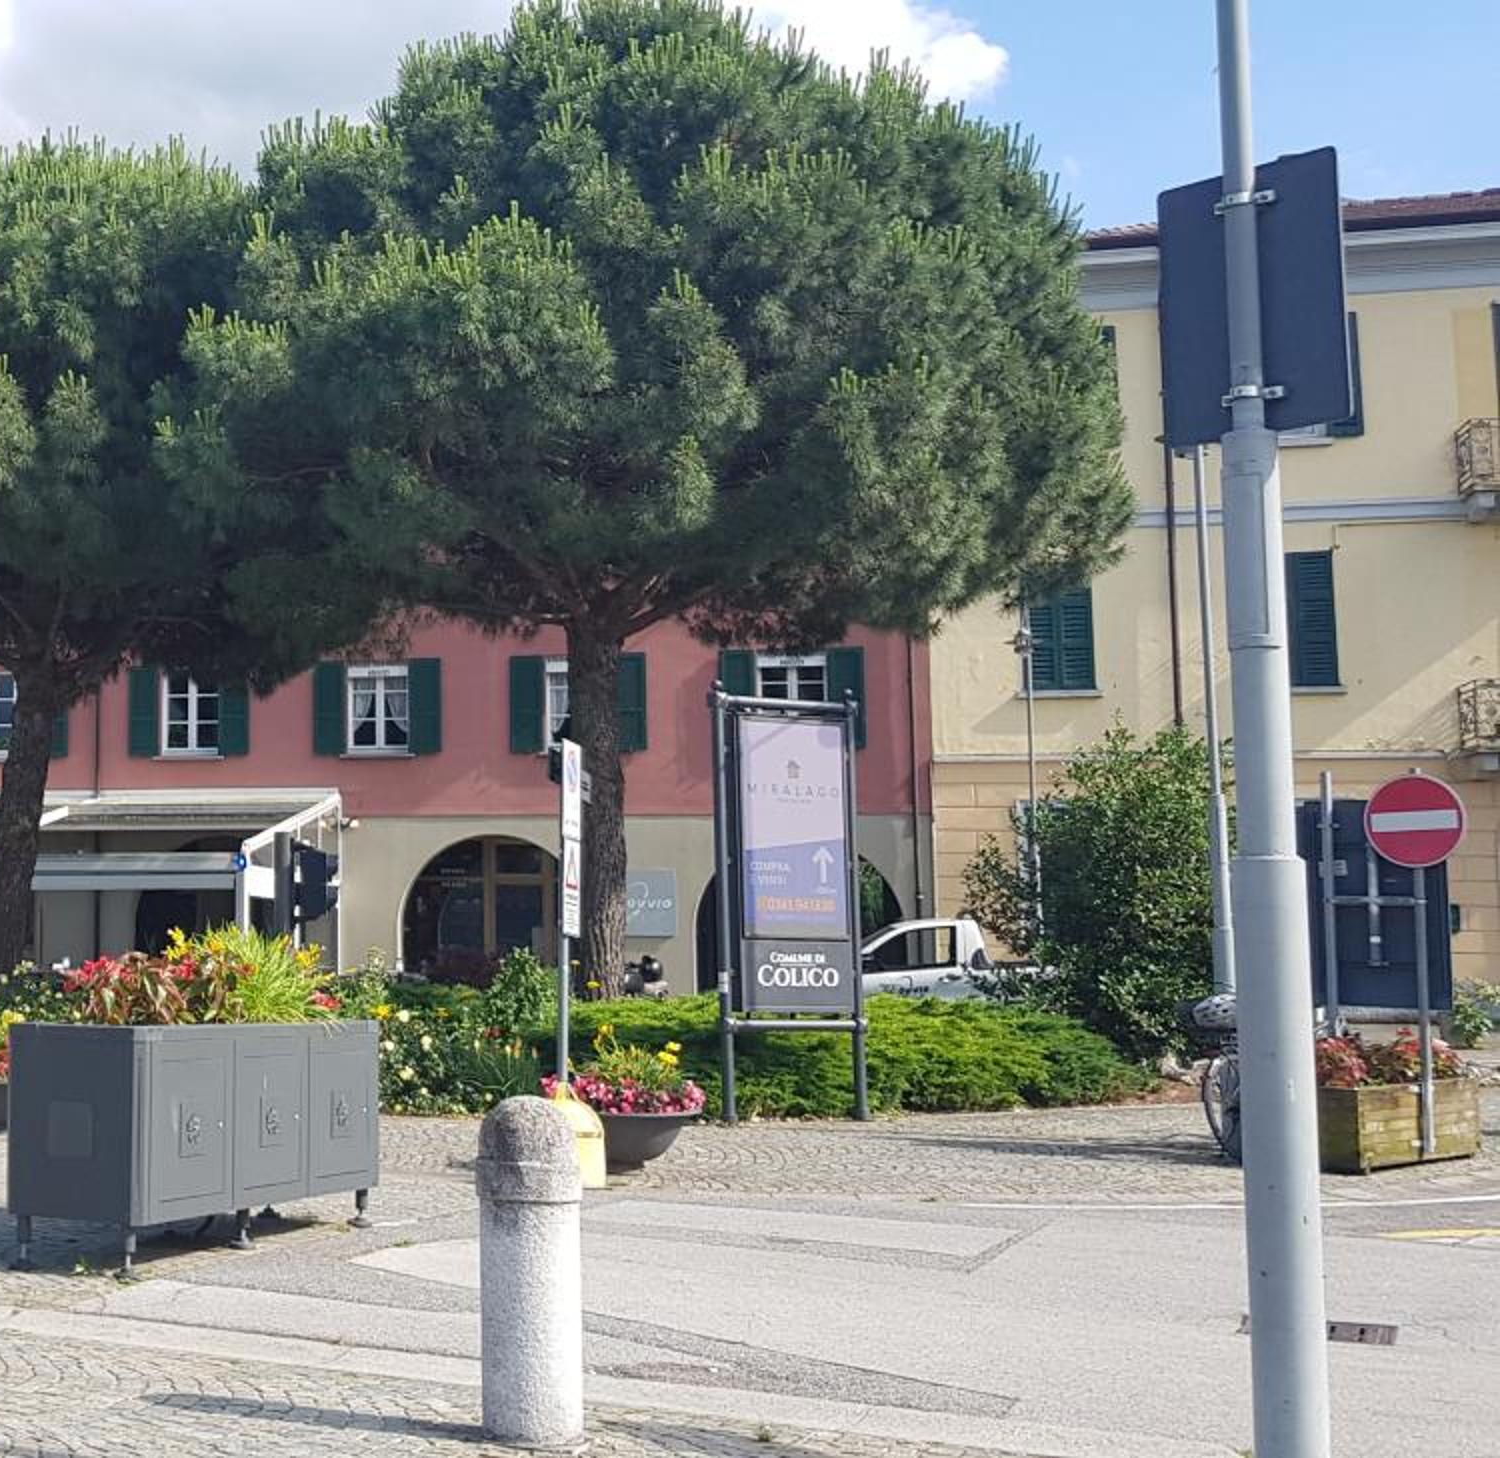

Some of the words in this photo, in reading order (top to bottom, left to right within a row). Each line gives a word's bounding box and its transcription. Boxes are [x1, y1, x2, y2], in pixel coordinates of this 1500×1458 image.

[746, 783, 840, 799] MIRALAGO
[769, 951, 812, 964] COMUNE
[815, 954, 826, 964] DI
[756, 964, 840, 988] COLICO
